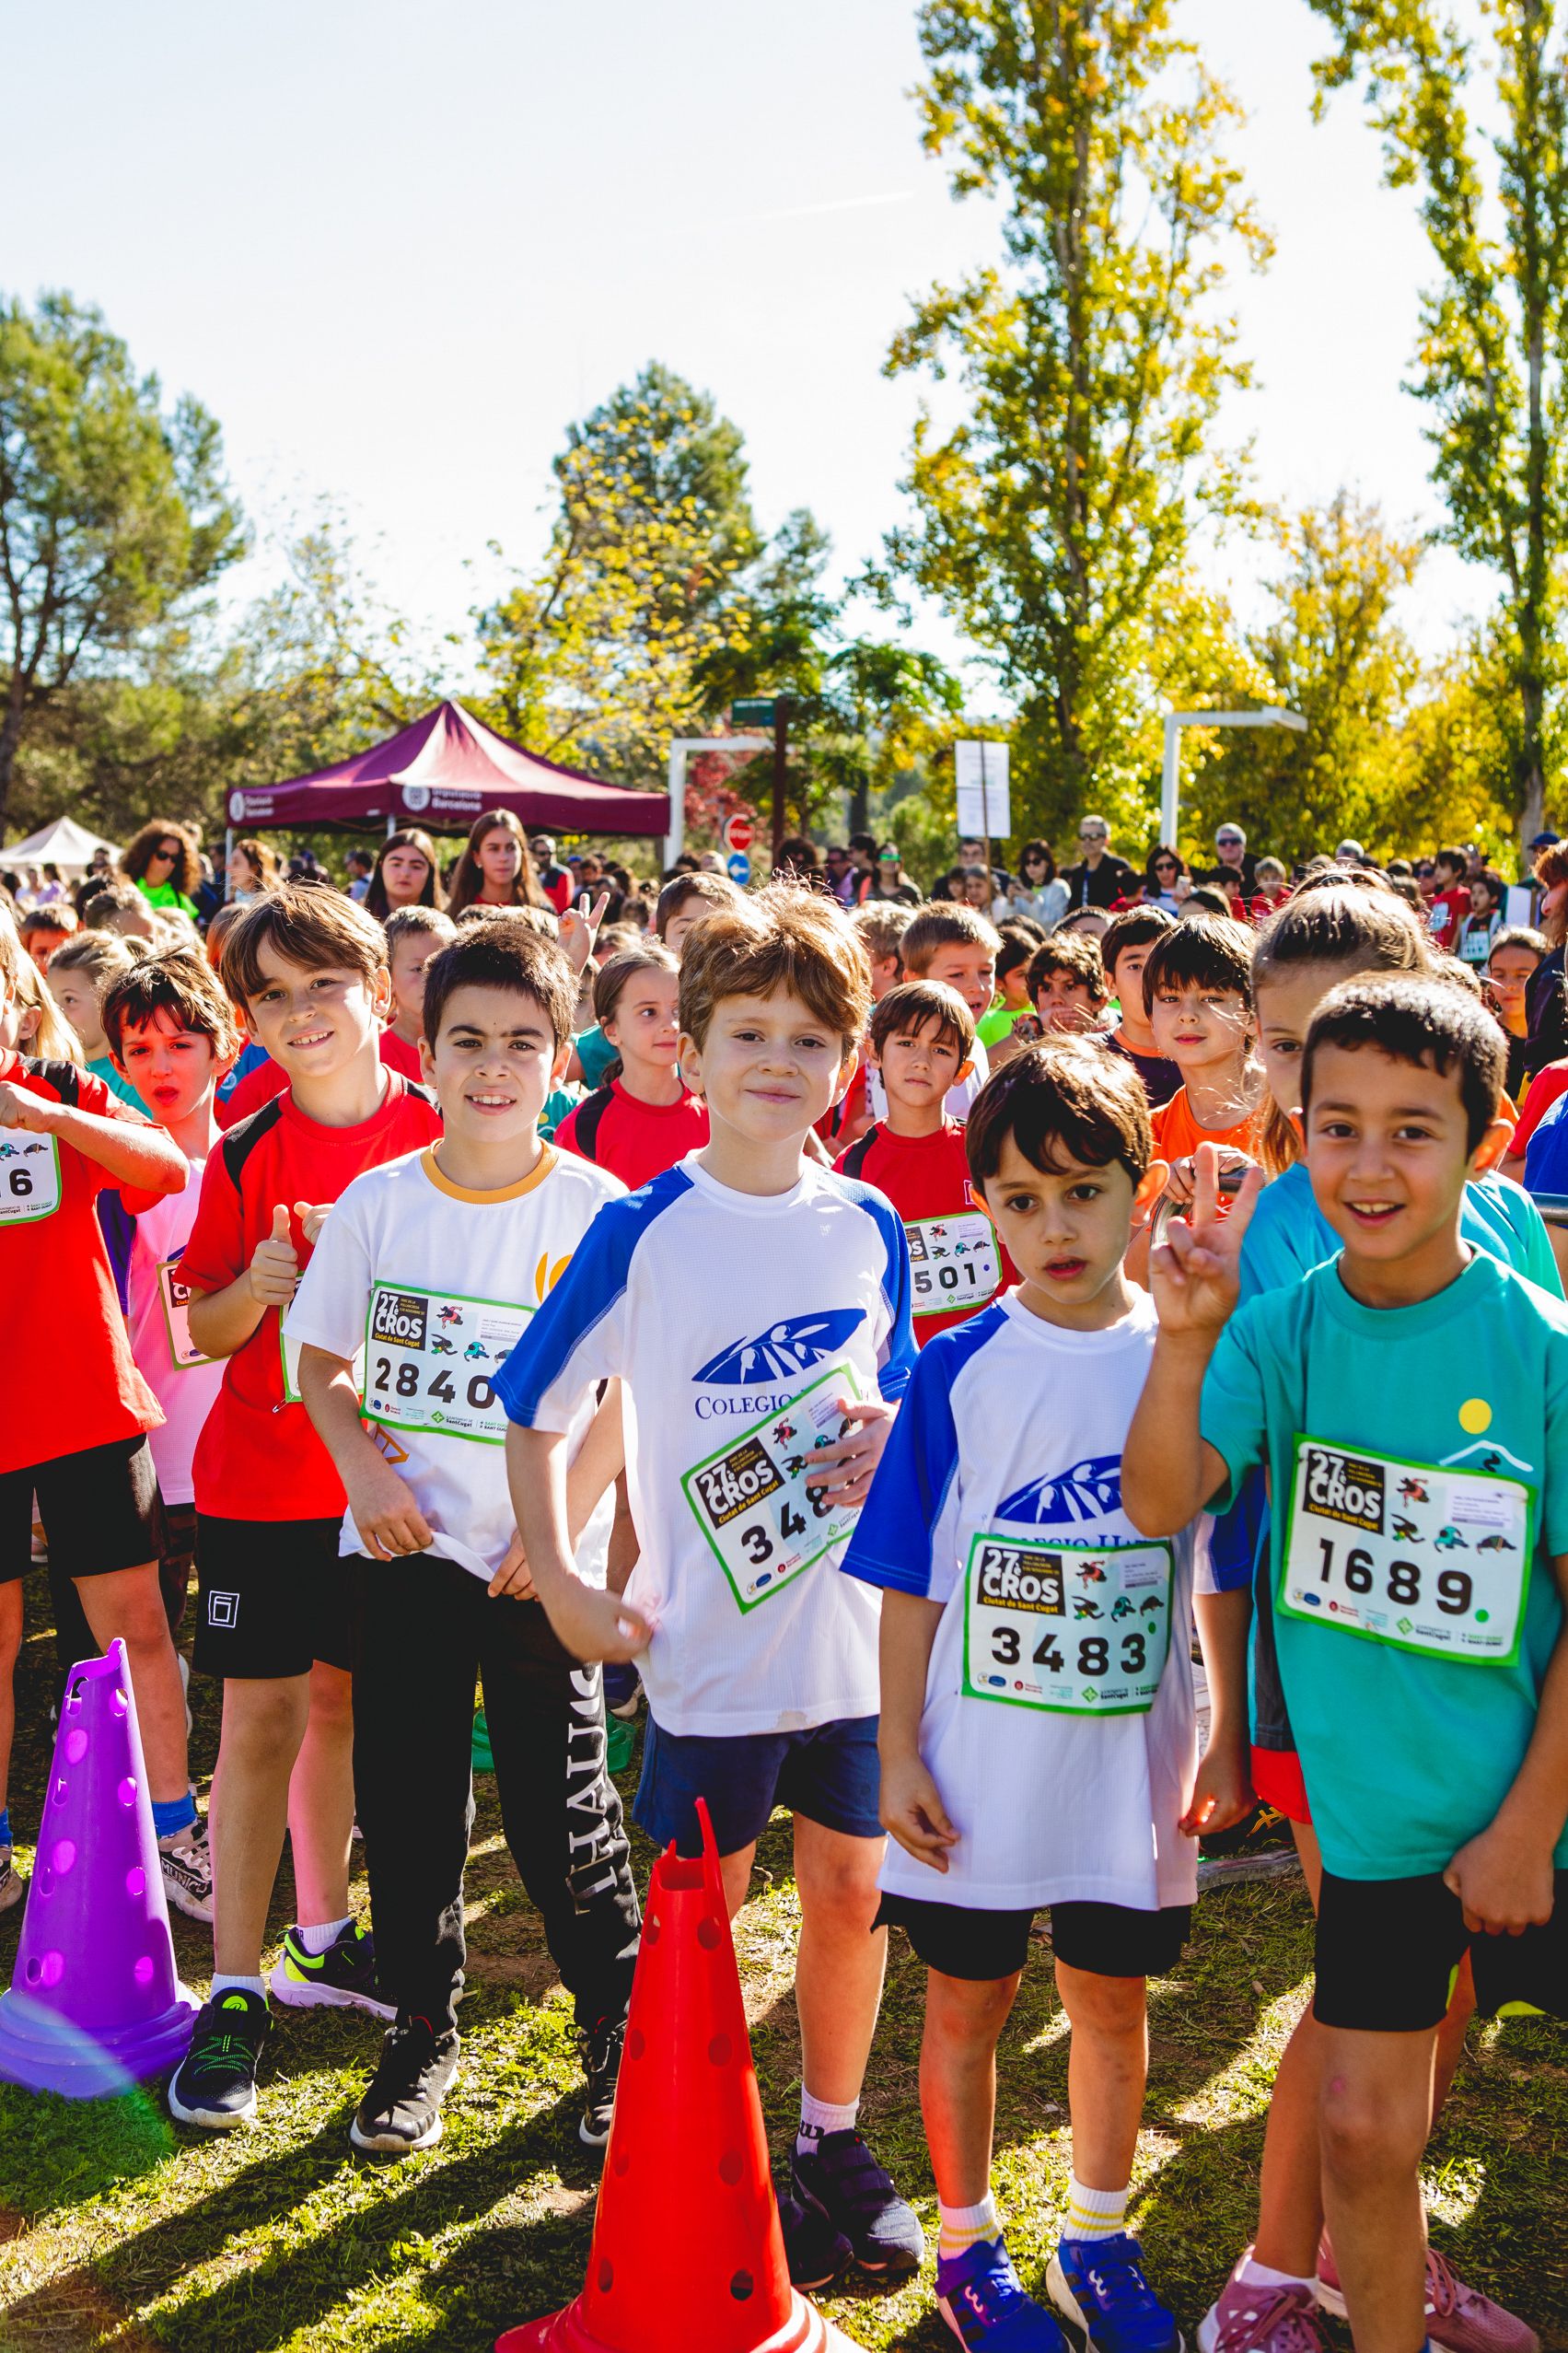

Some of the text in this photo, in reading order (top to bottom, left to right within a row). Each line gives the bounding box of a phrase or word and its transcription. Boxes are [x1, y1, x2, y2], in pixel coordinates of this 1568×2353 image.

[432, 798, 482, 811] Barcelona
[375, 1312, 424, 1339] CROS
[375, 1357, 496, 1409] 2840
[709, 1460, 773, 1515] CROS
[718, 1480, 780, 1525] Ciutat de Sant Cugat
[1308, 1478, 1381, 1520] CROS
[741, 1484, 836, 1564] 348
[982, 1571, 1060, 1604] CROS
[1318, 1537, 1472, 1615] 1689
[991, 1626, 1146, 1676] 3483
